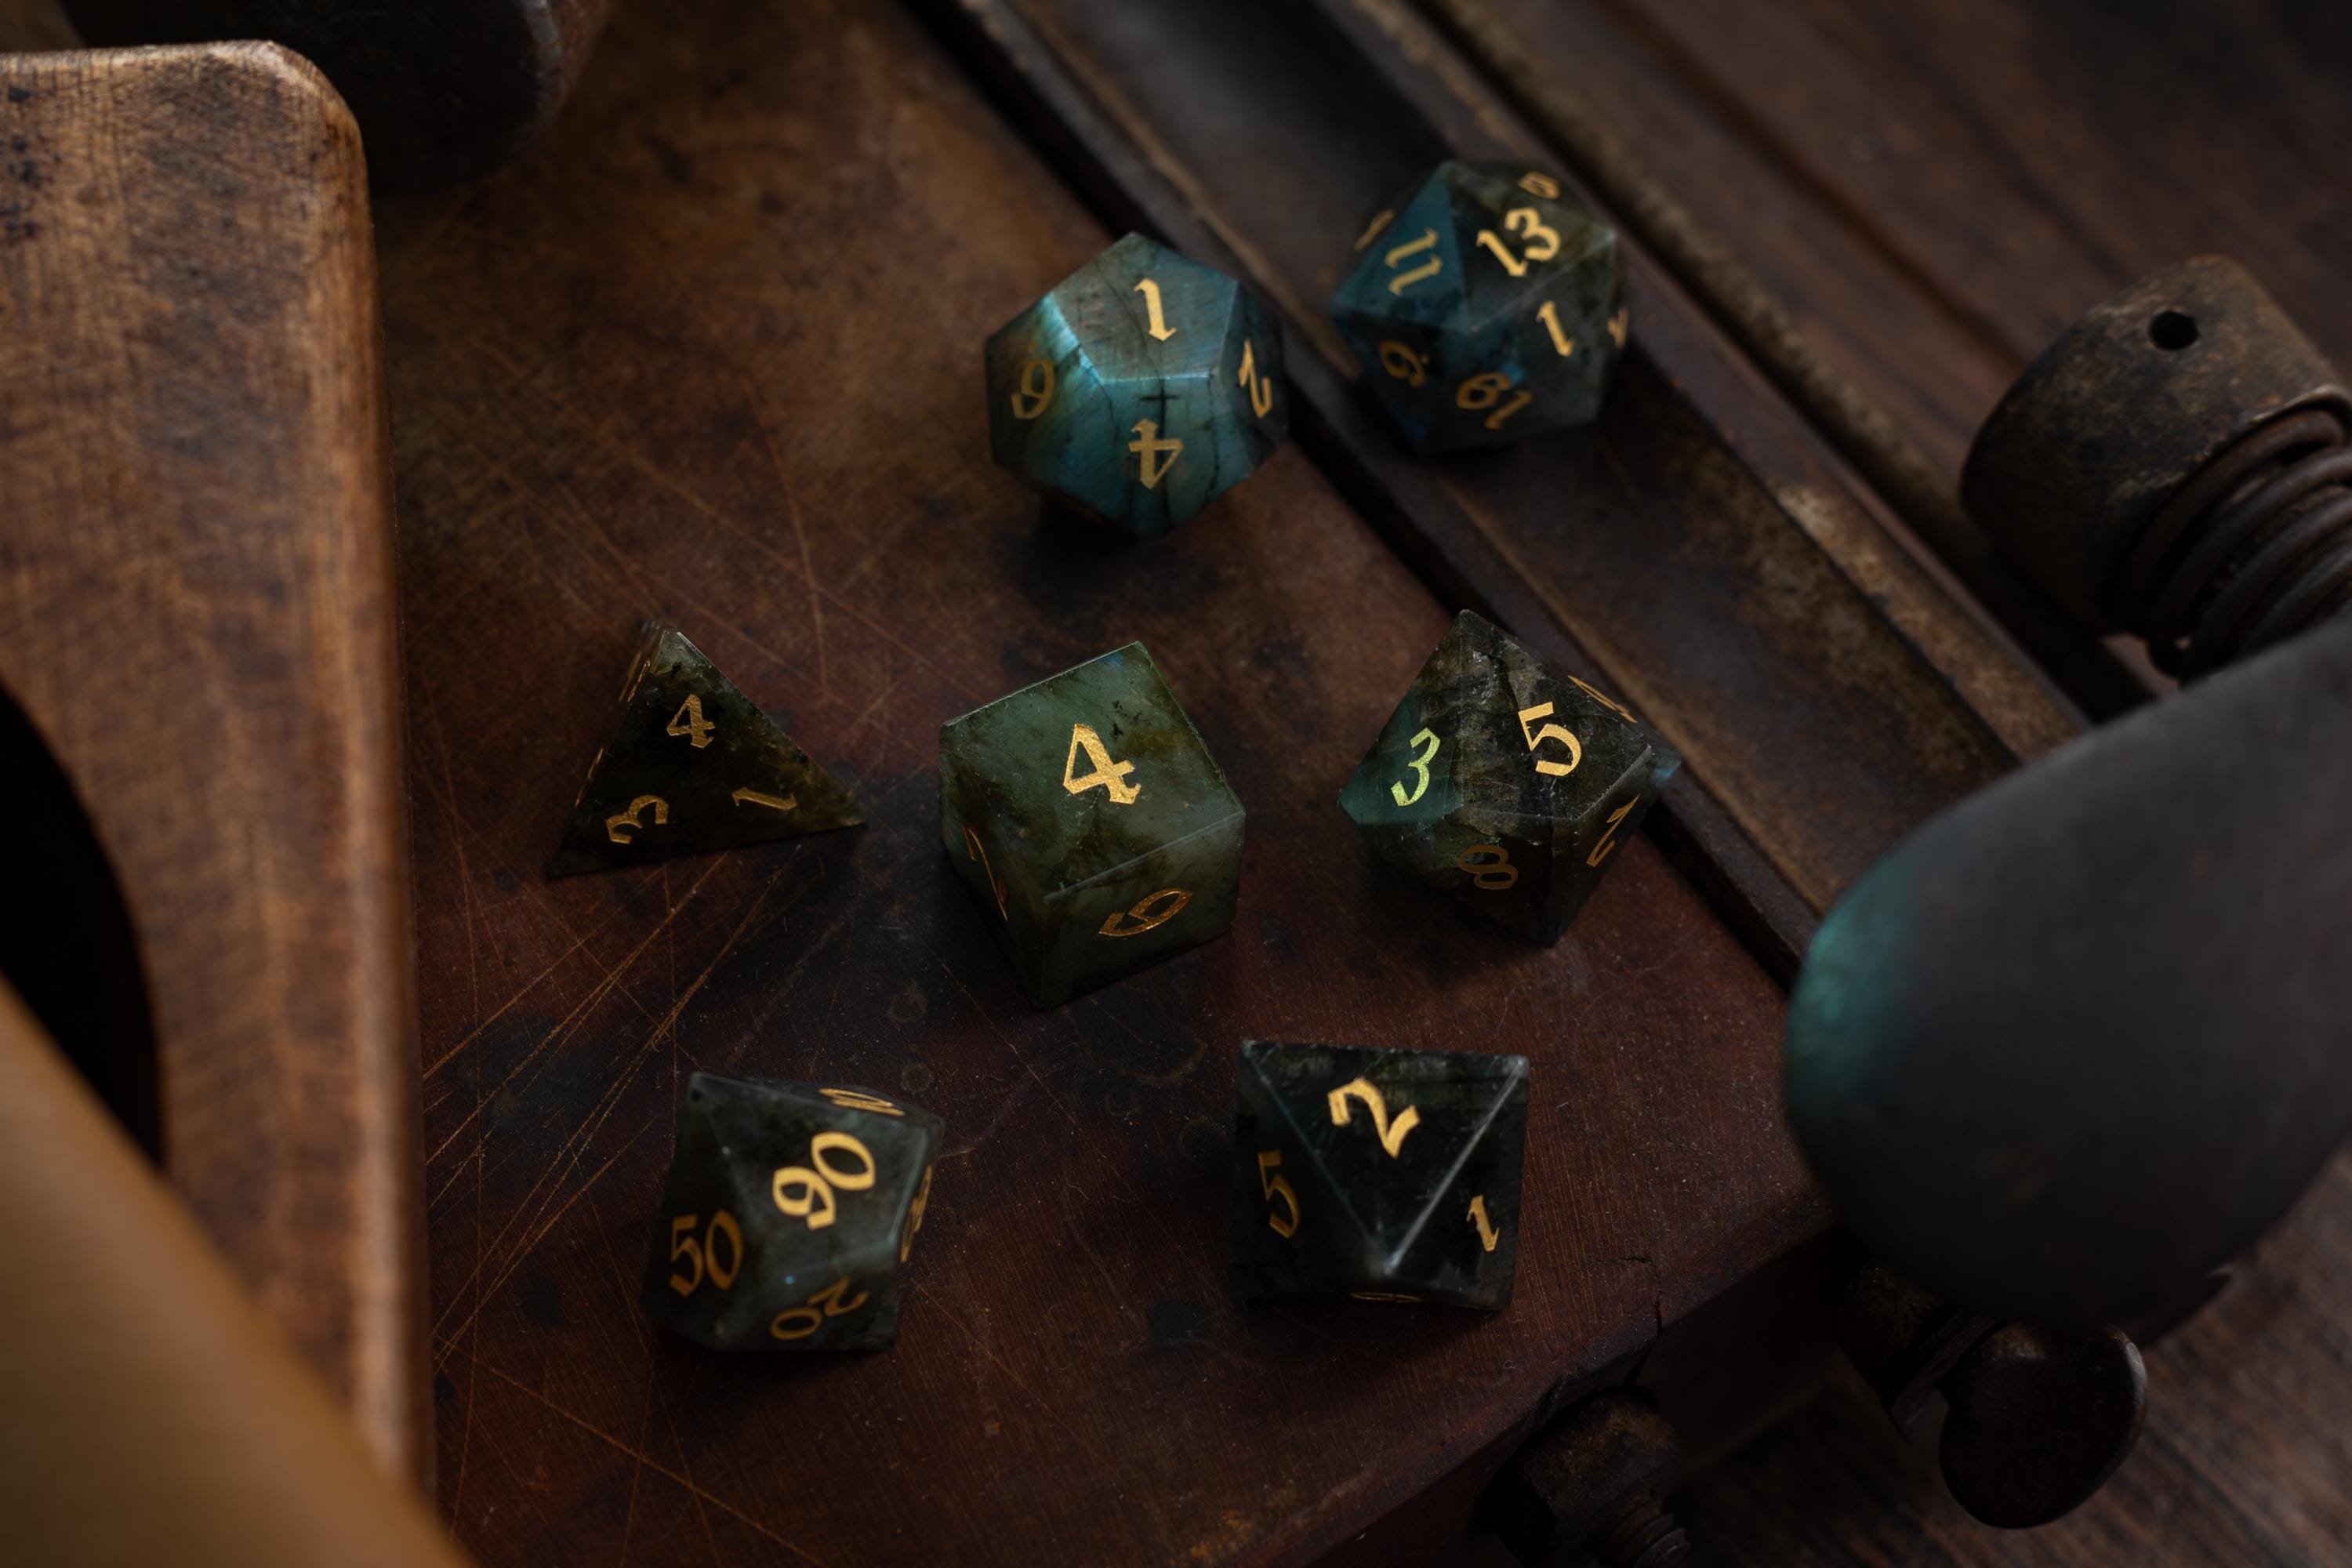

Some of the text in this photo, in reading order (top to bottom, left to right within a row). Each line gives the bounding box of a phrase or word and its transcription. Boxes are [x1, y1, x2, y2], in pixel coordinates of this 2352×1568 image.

[1476, 206, 1562, 278] 13
[1134, 278, 1177, 342] 1
[1128, 419, 1184, 490] 4
[667, 694, 715, 749] 4
[1519, 702, 1582, 777] 5
[732, 786, 799, 811] 1
[1063, 724, 1142, 804] 4
[1391, 728, 1441, 807] 3
[606, 794, 669, 844] 3
[1458, 846, 1519, 890] 8
[1327, 1076, 1421, 1159] 2
[772, 1131, 876, 1231] 90
[1258, 1149, 1300, 1239] 5
[670, 1209, 743, 1298] 50
[1467, 1194, 1501, 1252] 1
